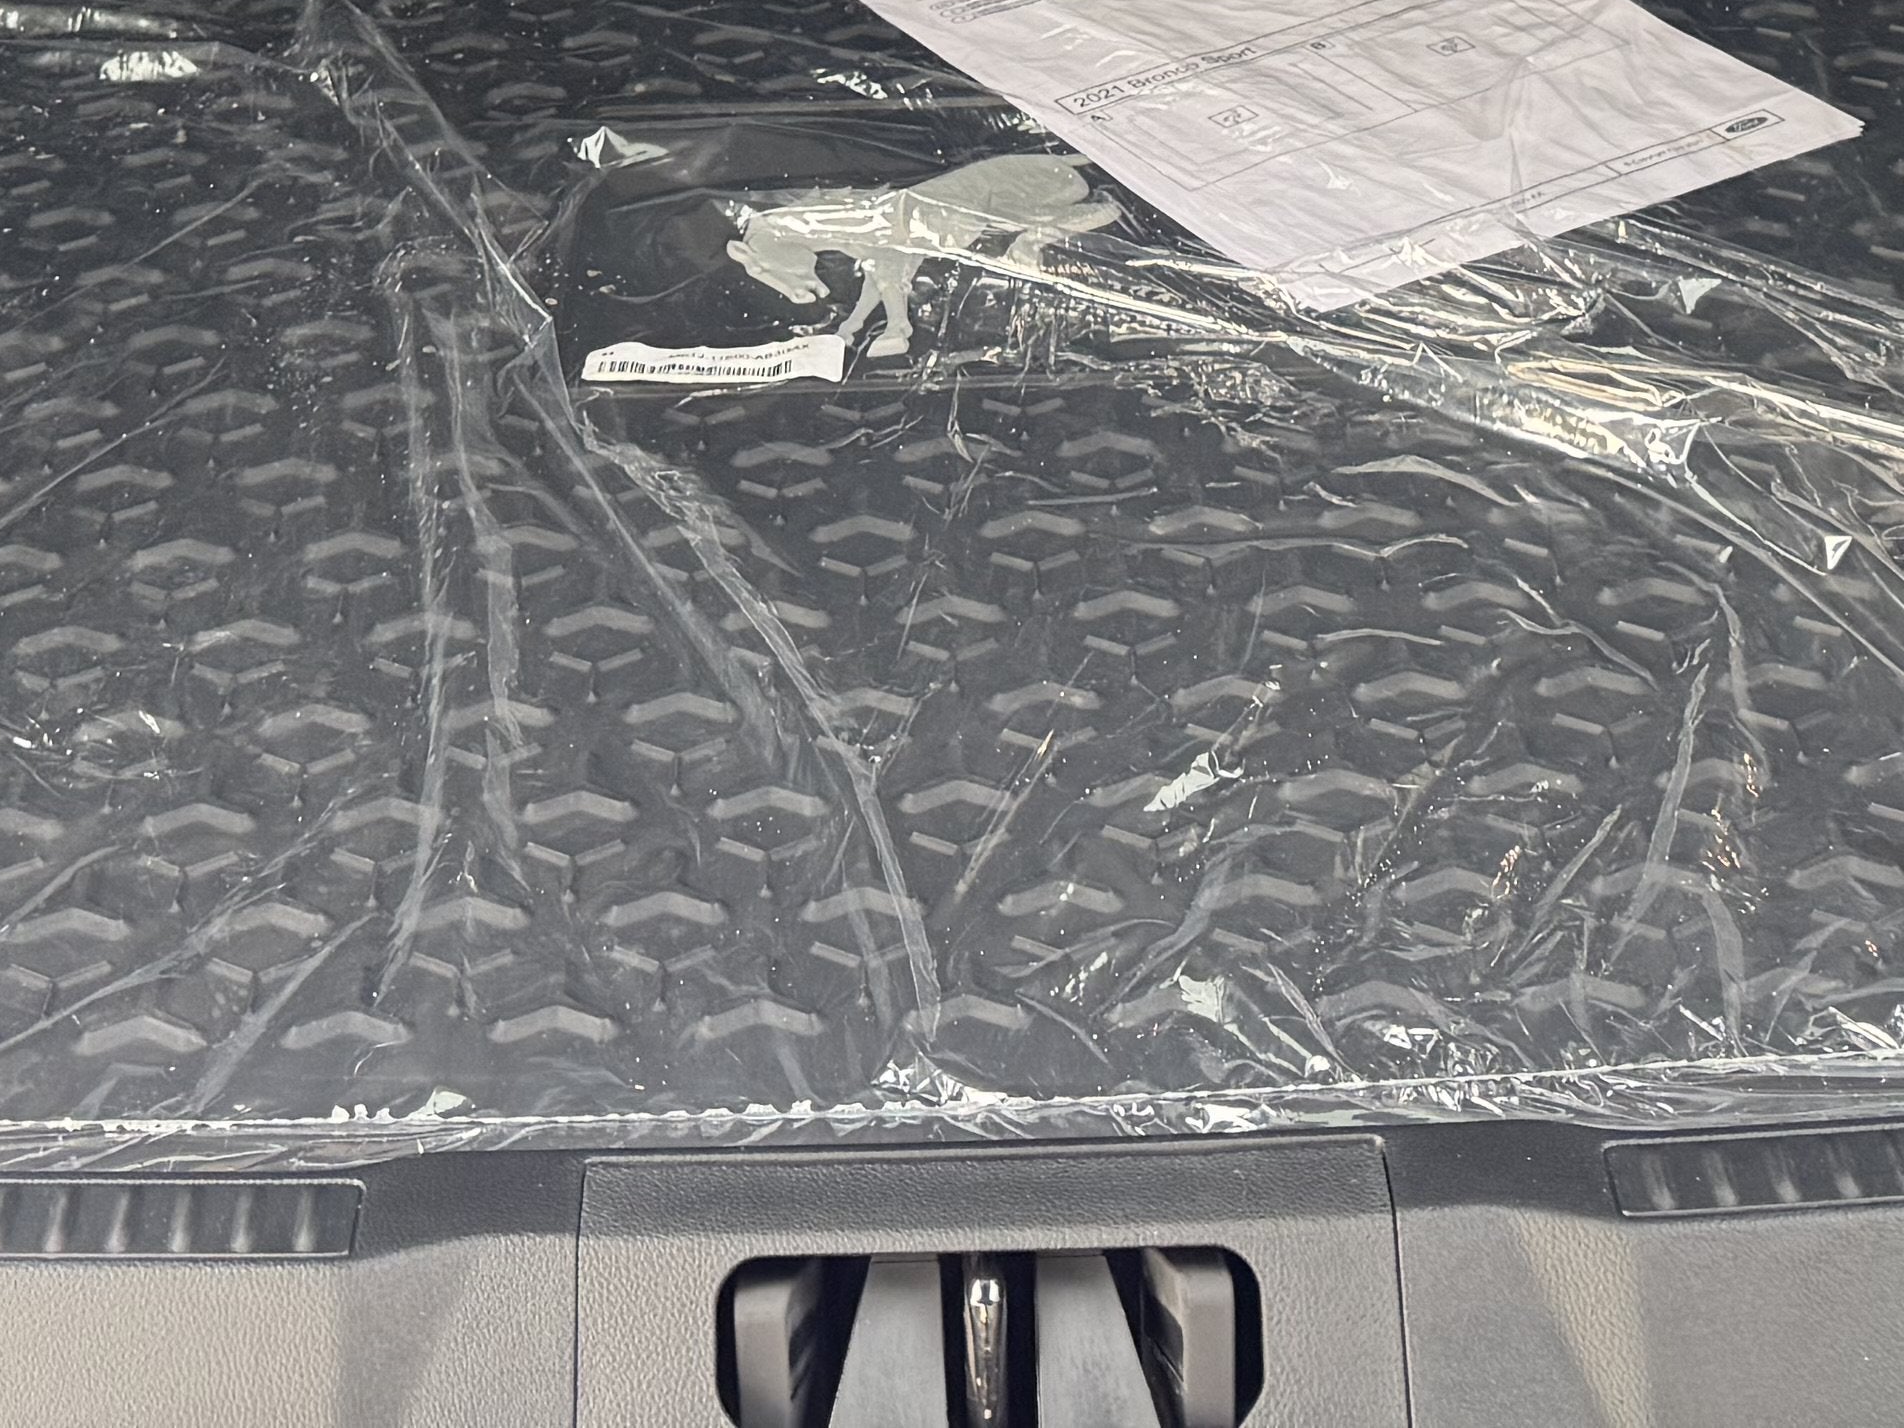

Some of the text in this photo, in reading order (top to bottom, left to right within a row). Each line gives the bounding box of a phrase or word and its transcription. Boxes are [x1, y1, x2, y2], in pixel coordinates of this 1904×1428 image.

[1073, 46, 1258, 108] 2021 Bronco Sport
[1731, 117, 1762, 133] Ford
